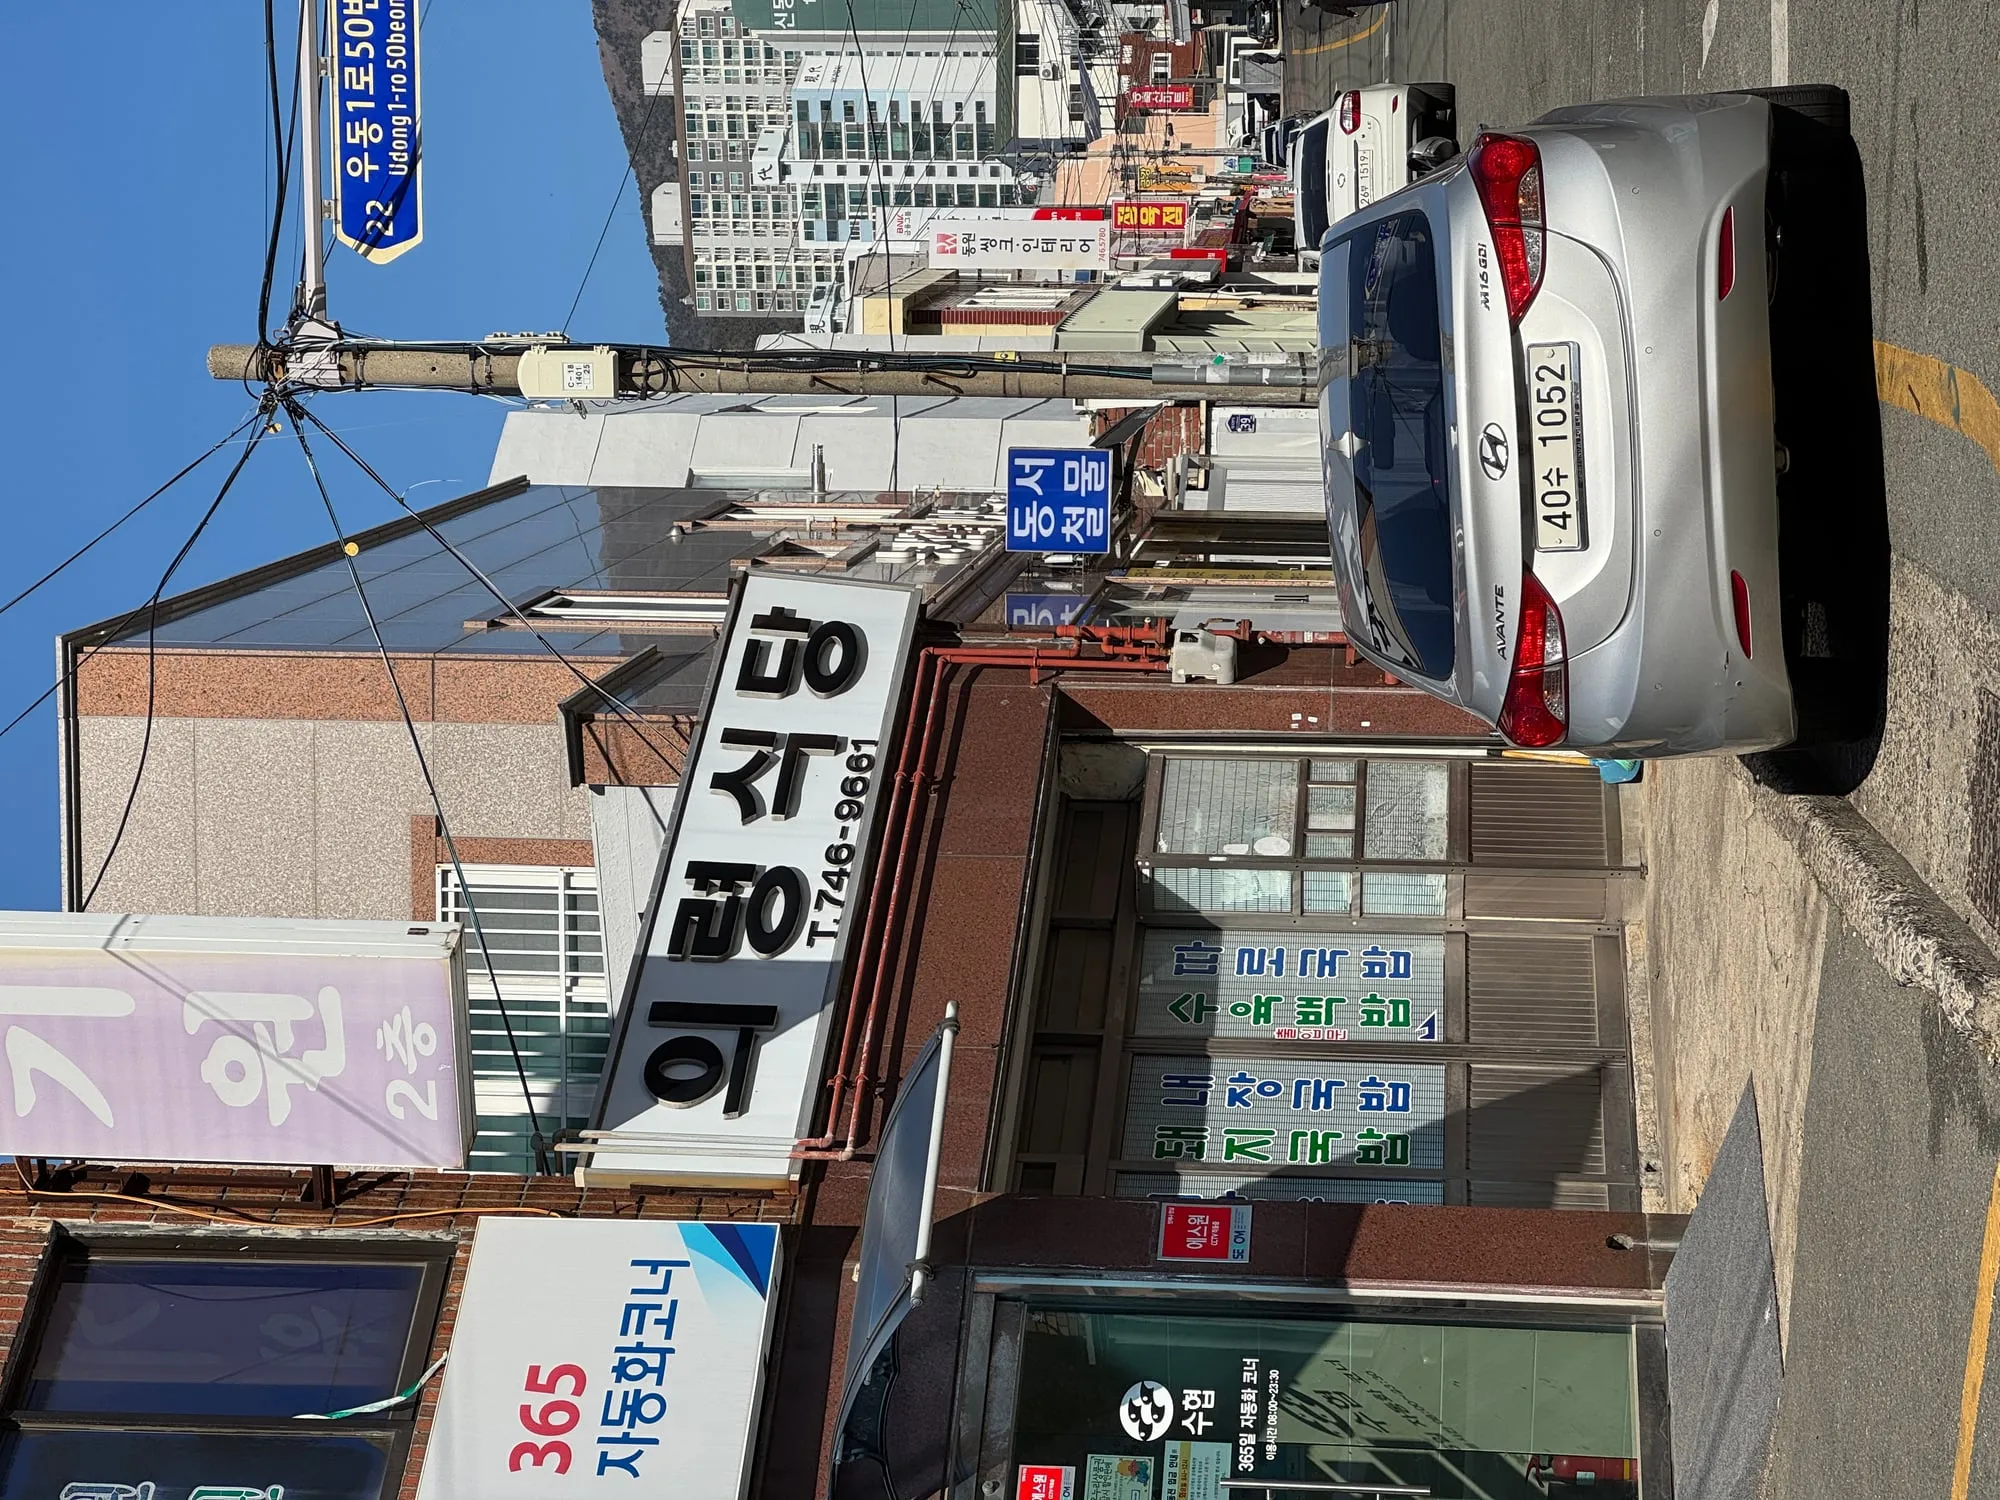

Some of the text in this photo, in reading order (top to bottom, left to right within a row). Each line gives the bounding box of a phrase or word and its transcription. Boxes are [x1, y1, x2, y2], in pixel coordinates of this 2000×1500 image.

[387, 73, 408, 111] 1-ro
[387, 115, 412, 175] Udong
[1360, 155, 1369, 180] 1519
[365, 200, 394, 237] 22
[961, 232, 977, 257] 동원
[1240, 417, 1251, 429] 39
[1535, 363, 1572, 531] 40수 1052
[1014, 457, 1056, 543] 동서
[1061, 455, 1106, 544] 철물
[1494, 584, 1507, 661] AVANTE
[640, 606, 866, 1122] 의령식당
[804, 738, 880, 948] T.746-9661
[1172, 940, 1414, 980] 따로국밥
[376, 1006, 438, 1121] 2층
[1274, 1028, 1348, 1040] 출입문
[1160, 1070, 1413, 1113] 내장국밥
[1152, 1125, 1411, 1167] 돼지국밥
[1186, 1214, 1210, 1250] 에스원
[595, 1257, 691, 1479] 자동화코너
[508, 1363, 587, 1475] 365
[1181, 1389, 1216, 1435] 수협
[1238, 1358, 1260, 1472] 365일 자동화 코너
[1266, 1369, 1280, 1460] 이용시간 08:00~23:30
